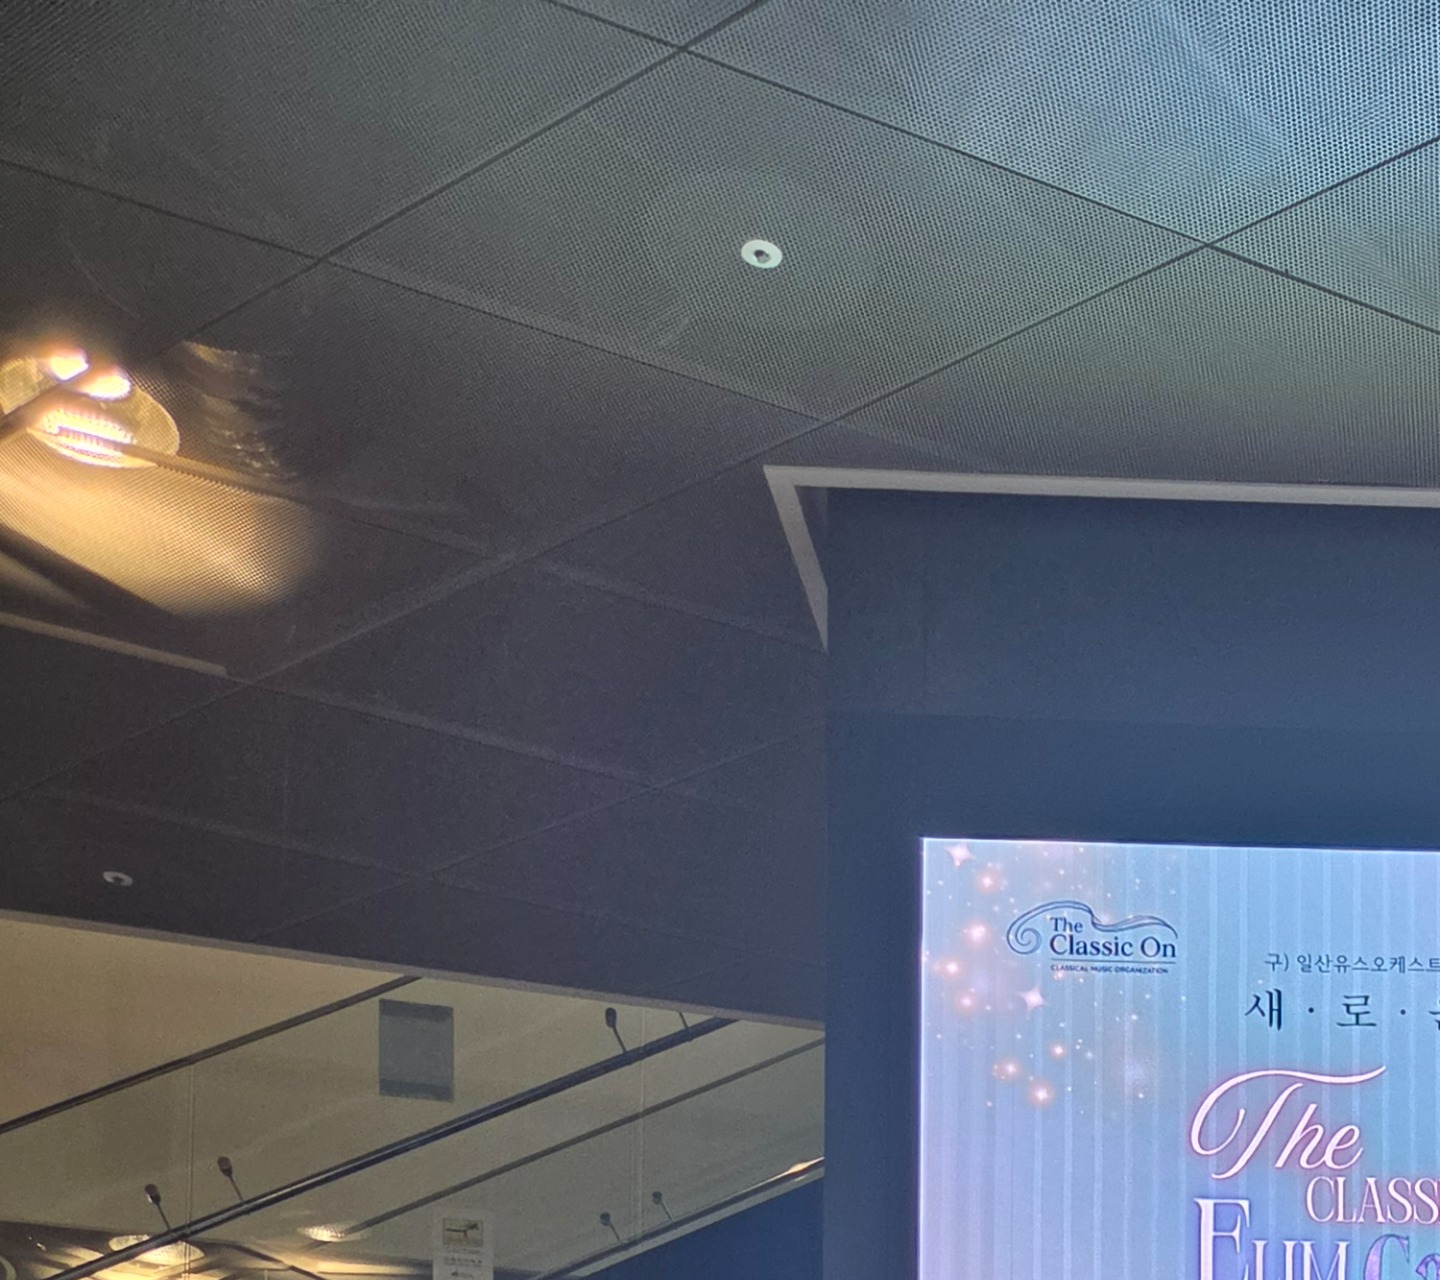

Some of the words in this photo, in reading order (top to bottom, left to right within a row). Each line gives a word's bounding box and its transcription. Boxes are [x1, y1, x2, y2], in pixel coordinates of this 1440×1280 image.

[1050, 916, 1083, 933] The
[1050, 934, 1133, 957] Classic
[1141, 936, 1176, 957] On
[1265, 952, 1289, 972] 구)
[1190, 1065, 1387, 1180] The
